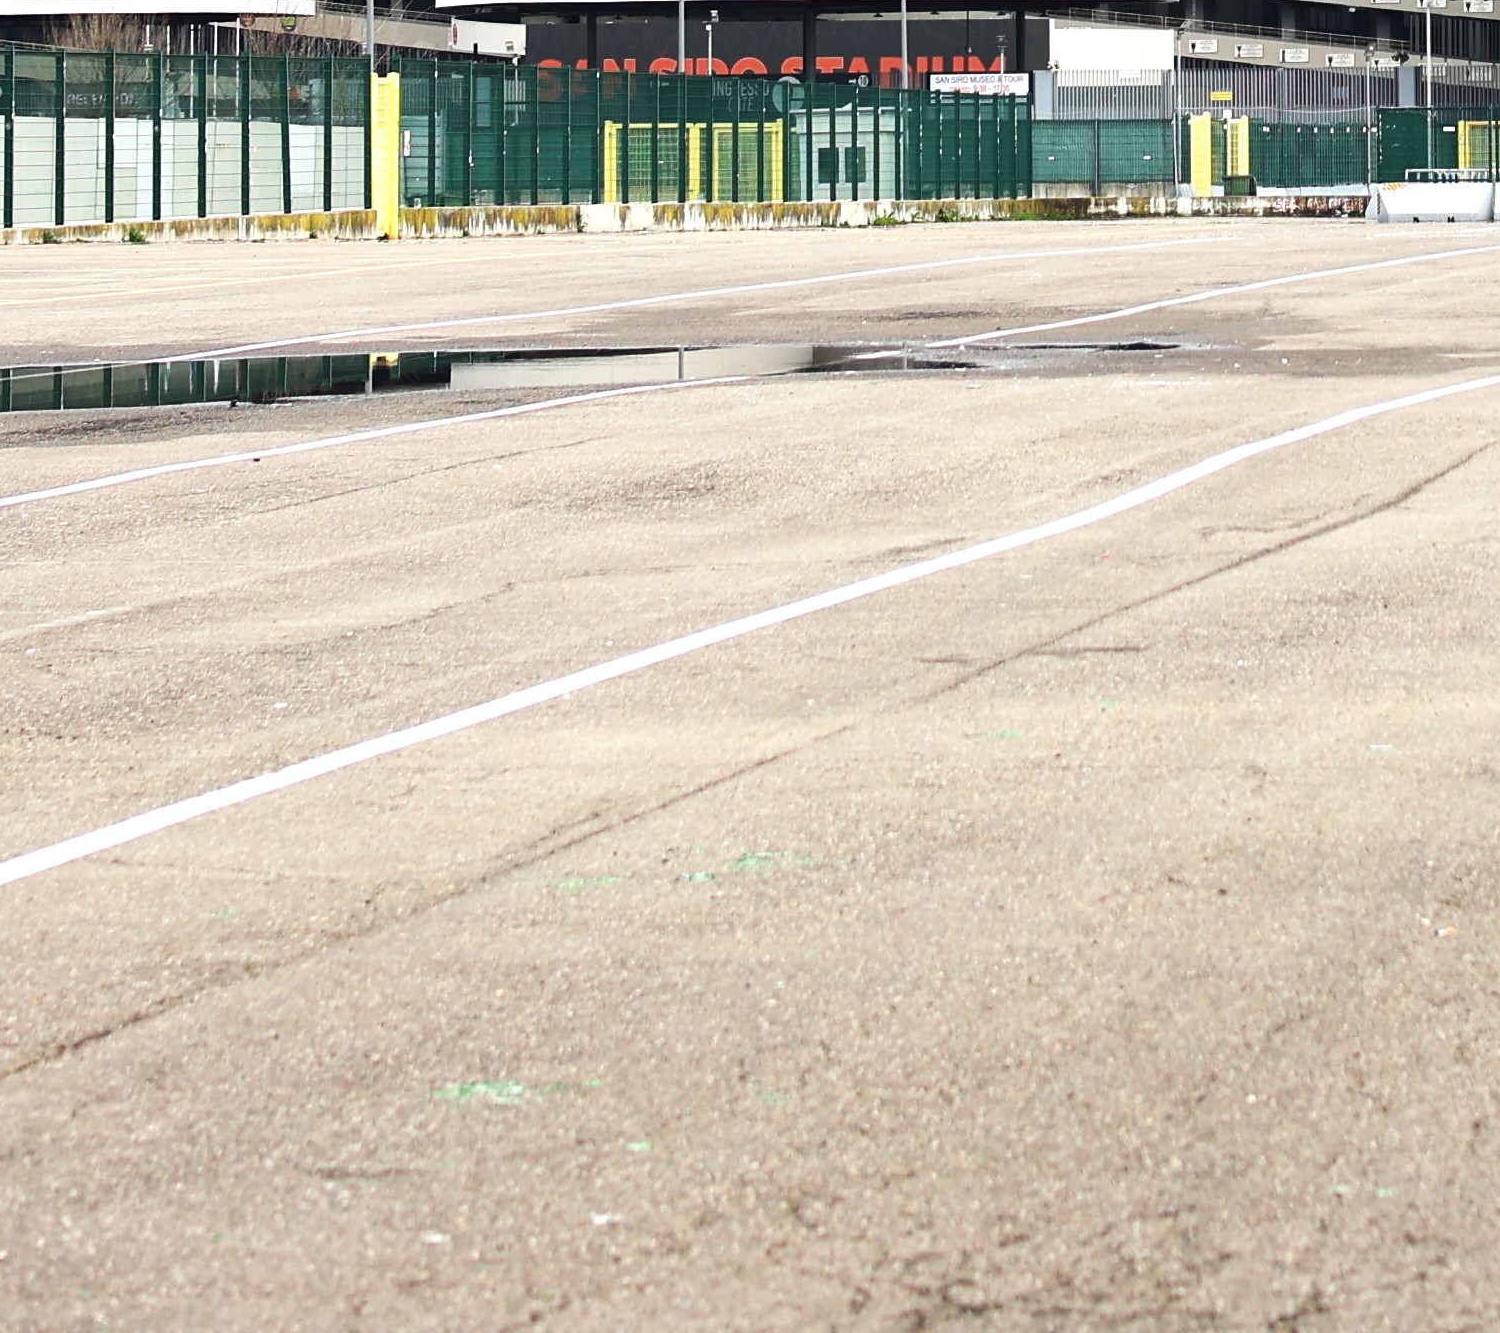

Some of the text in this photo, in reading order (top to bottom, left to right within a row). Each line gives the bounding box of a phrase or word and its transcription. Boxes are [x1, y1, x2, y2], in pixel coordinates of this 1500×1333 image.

[935, 75, 950, 84] SAN
[951, 75, 969, 84] SIRO
[1003, 75, 1024, 83] TOUR
